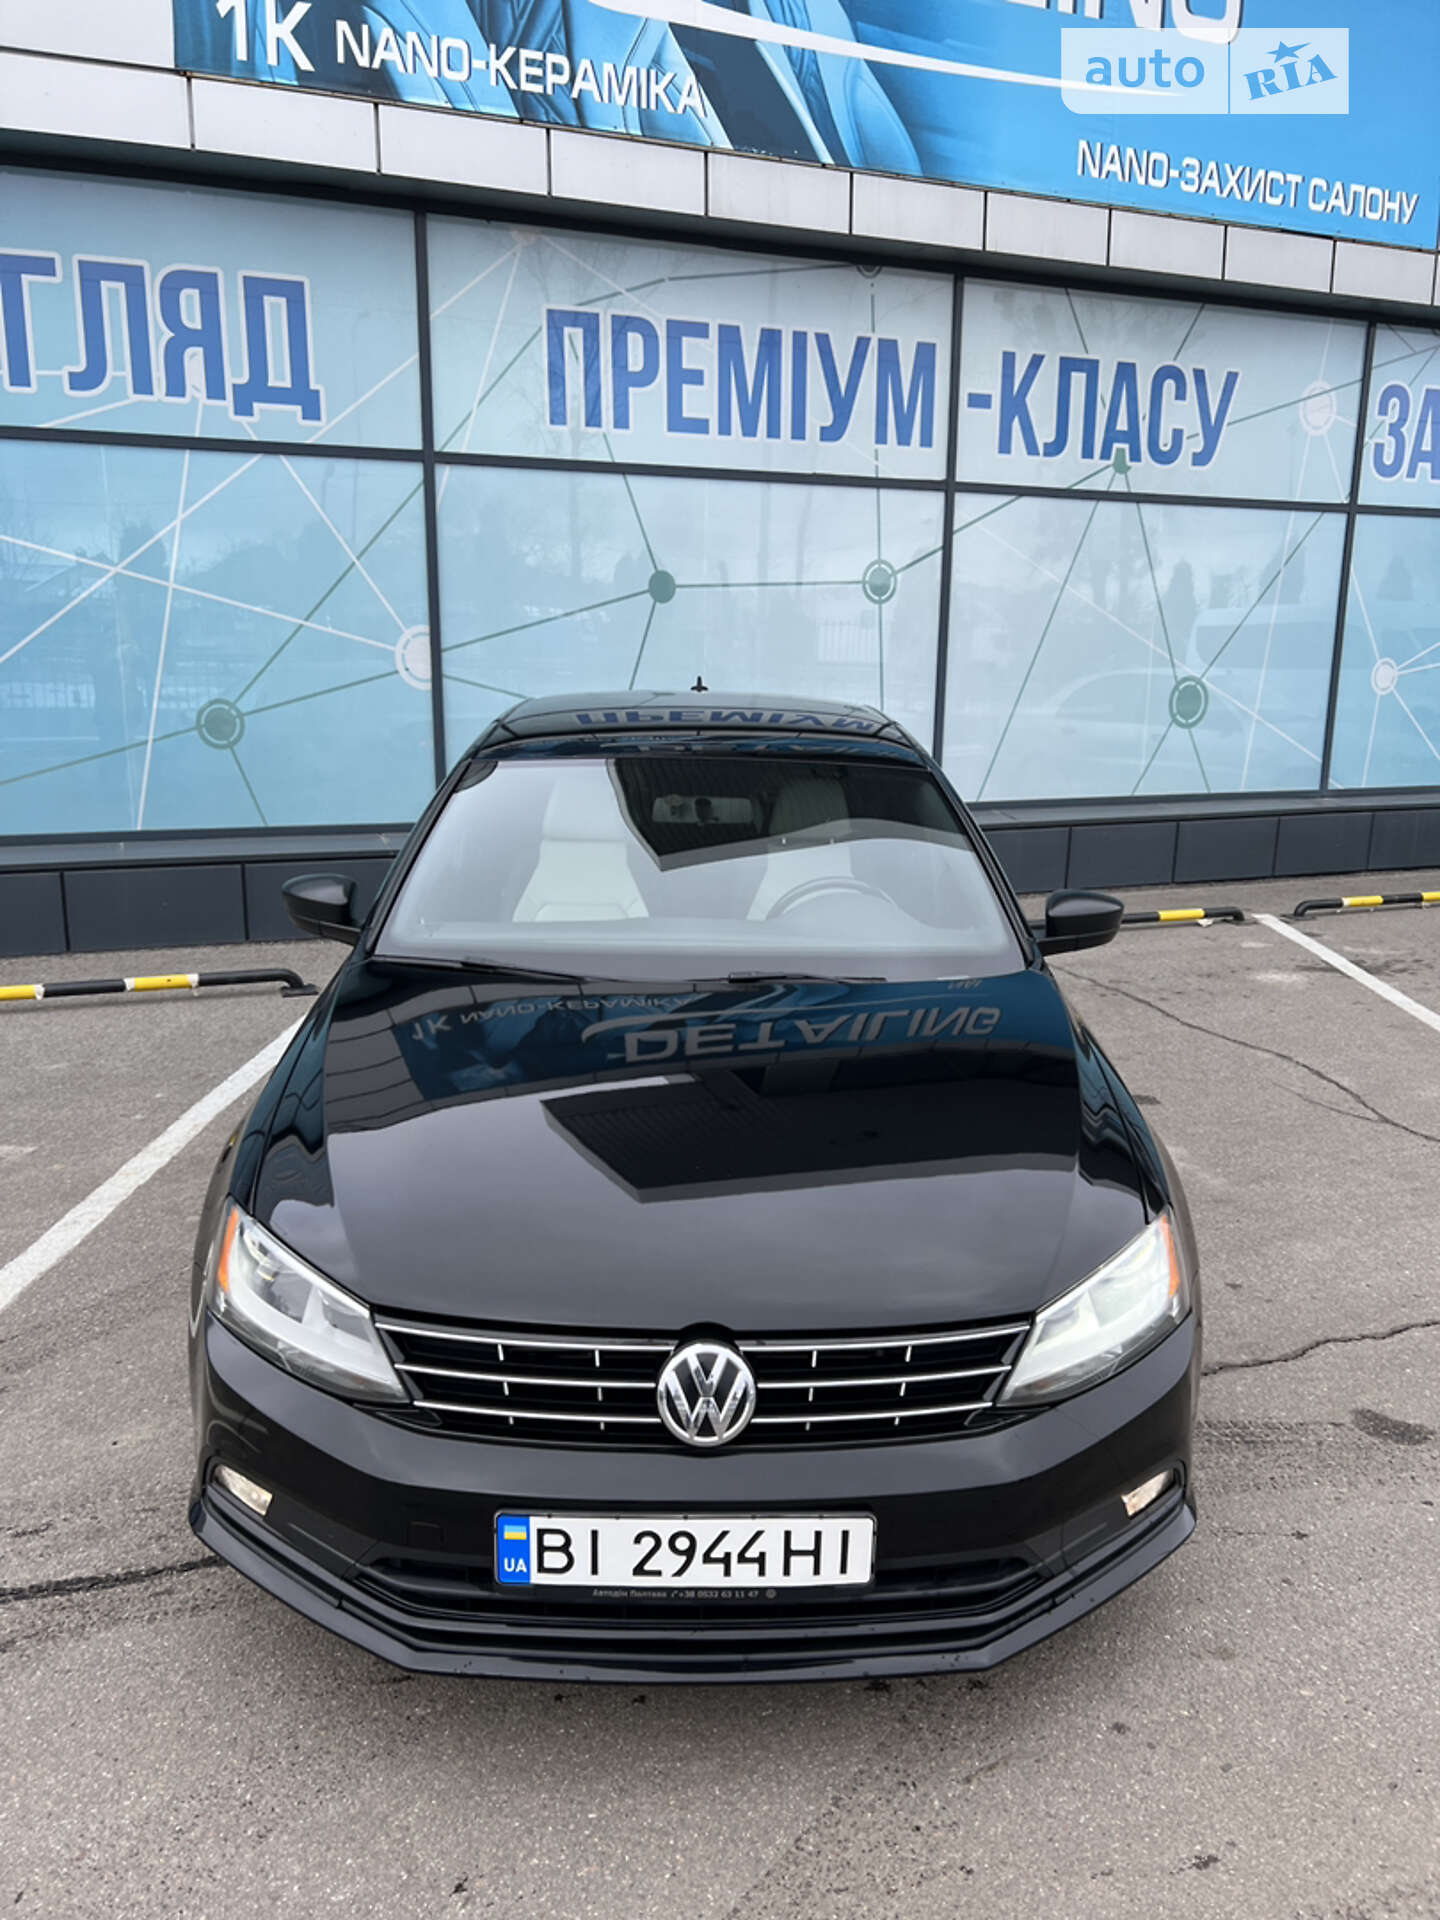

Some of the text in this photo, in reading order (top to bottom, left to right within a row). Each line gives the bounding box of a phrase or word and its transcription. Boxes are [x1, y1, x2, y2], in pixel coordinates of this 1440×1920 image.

[1076, 140, 1419, 226] NANO-ЗАХИСТ САЛОНУ
[545, 308, 939, 450] ПРЕМІУМ
[504, 1558, 527, 1573] UA
[536, 1528, 599, 1576] BI
